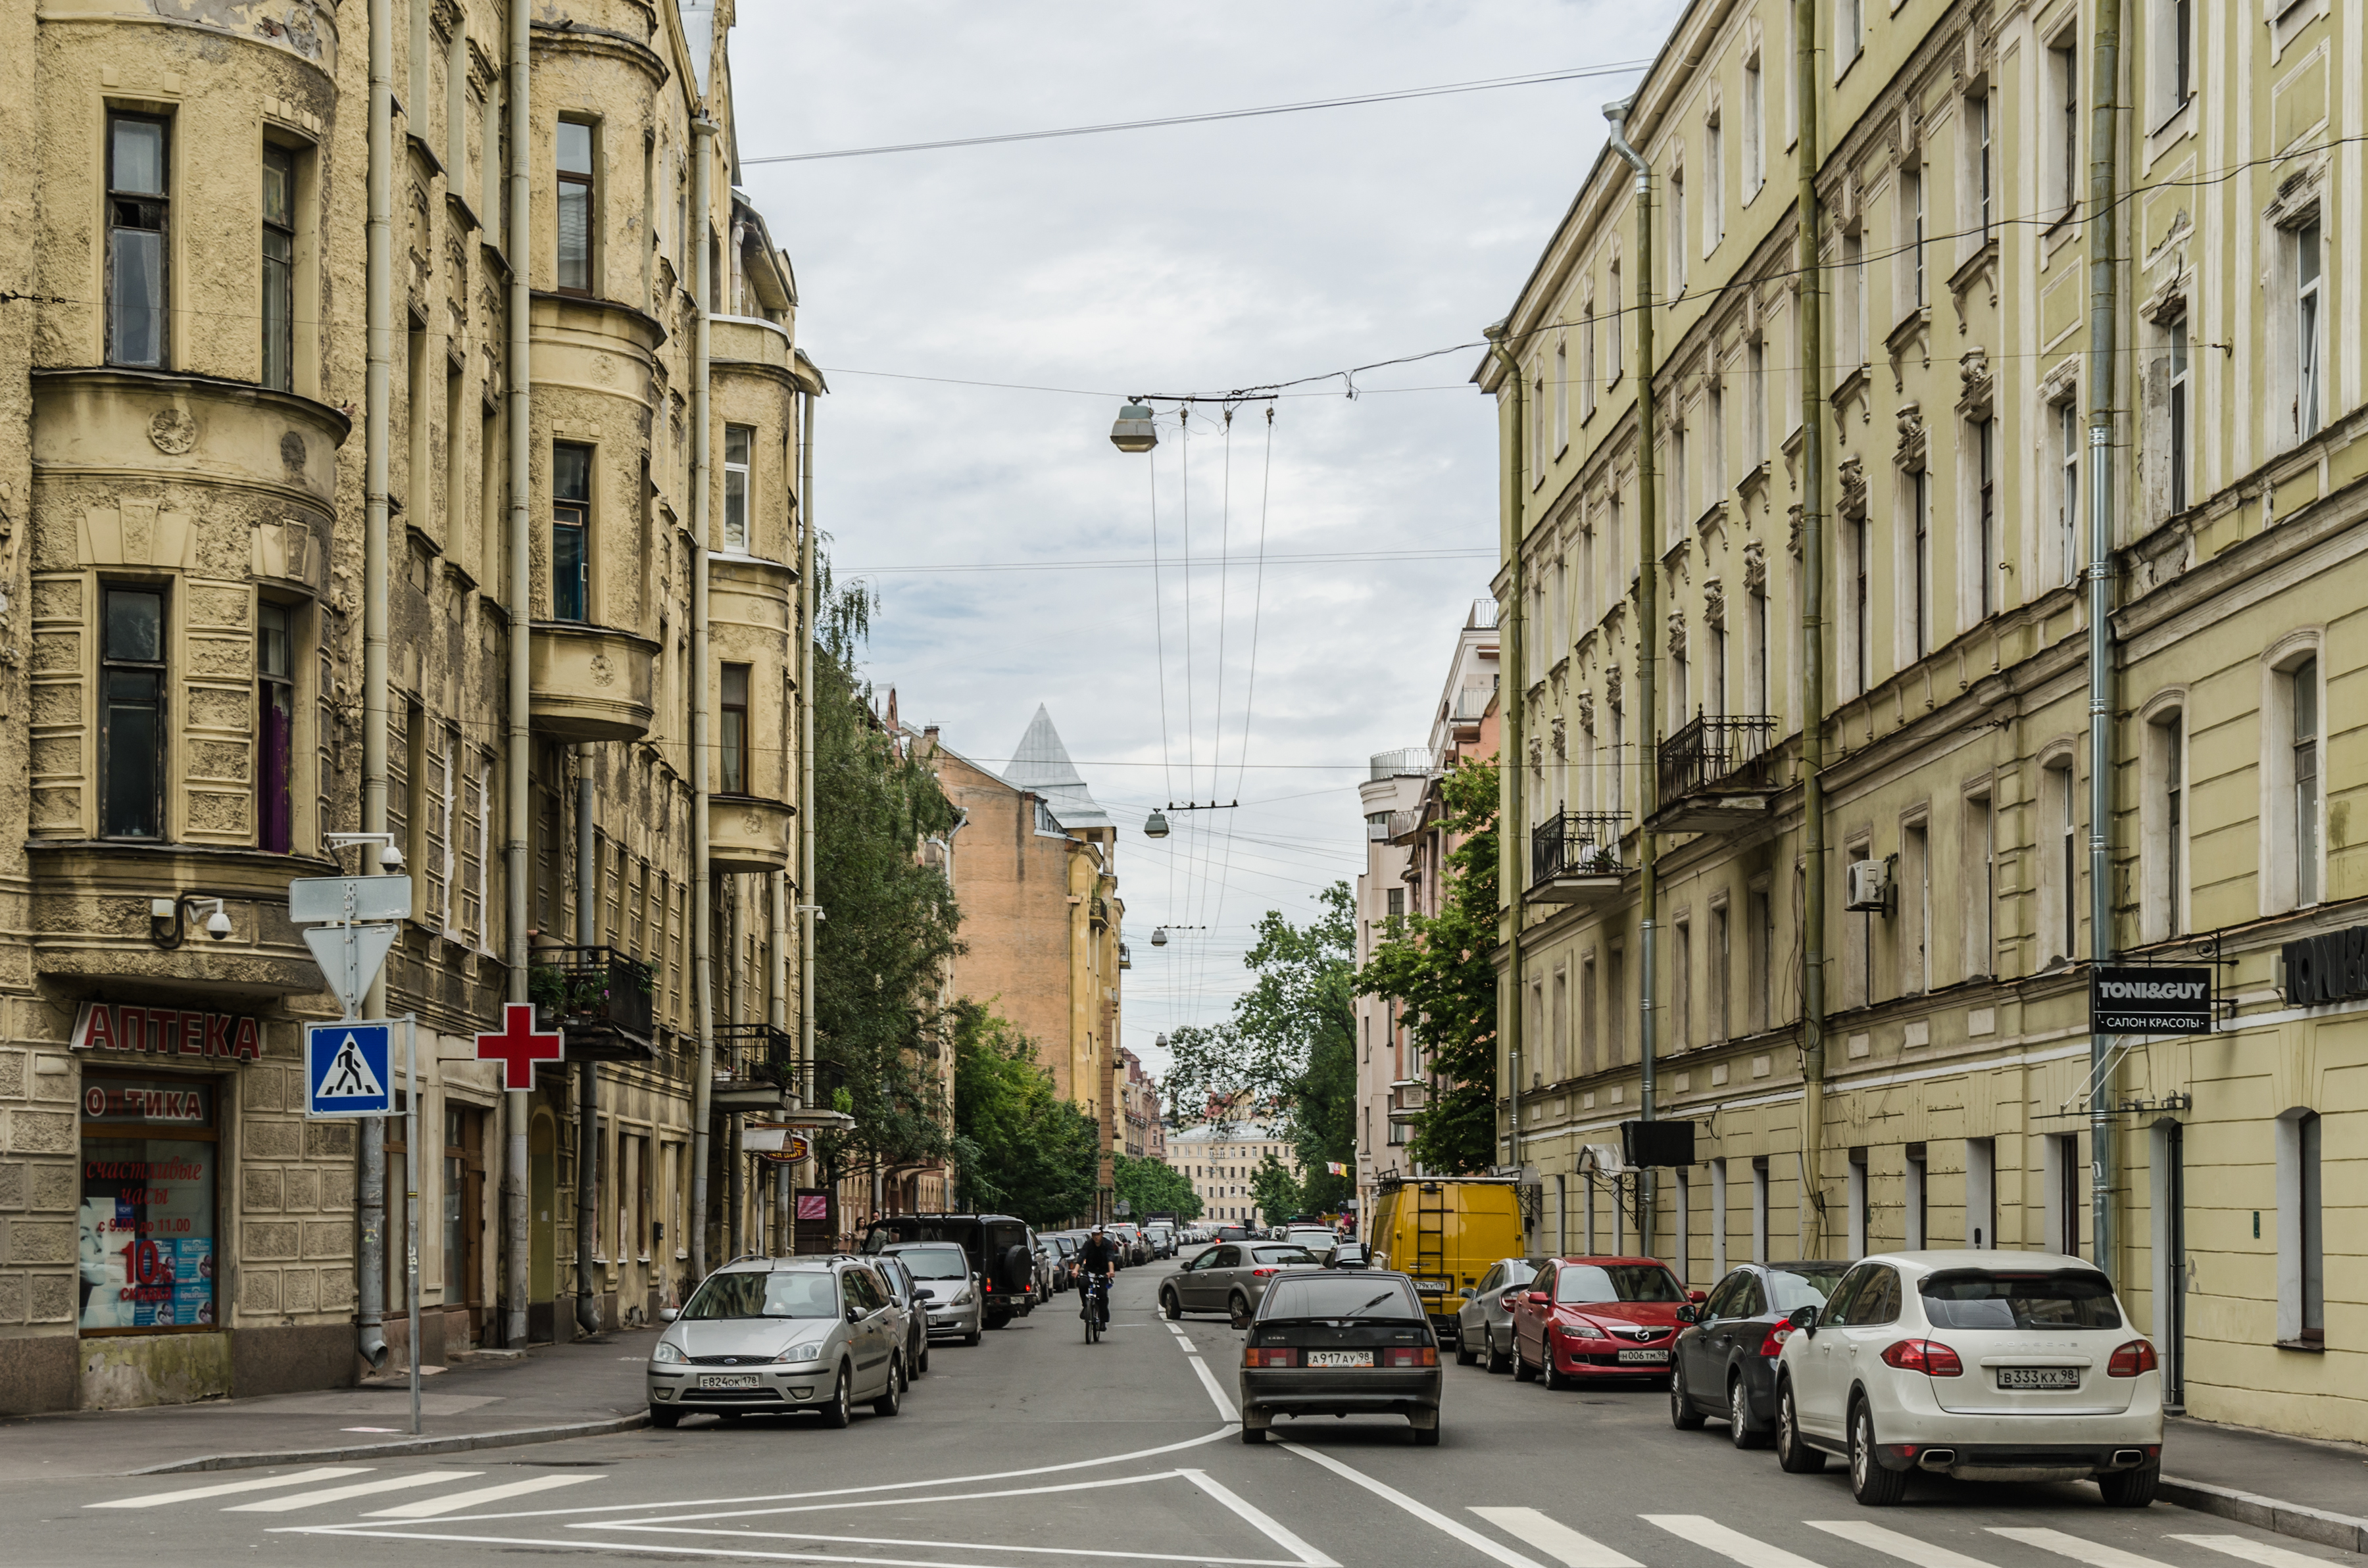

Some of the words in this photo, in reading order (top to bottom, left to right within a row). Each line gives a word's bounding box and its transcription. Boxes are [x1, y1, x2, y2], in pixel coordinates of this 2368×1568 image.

[2099, 982, 2206, 999] TONI&GUY
[78, 1002, 262, 1060] АПТЕКА
[2106, 1017, 2146, 1027] САЛОН
[2149, 1018, 2200, 1028] КРАСОТЫ
[86, 1087, 203, 1120] ОПТИКА
[86, 1156, 202, 1181] счастливые
[121, 1188, 169, 1205] часы
[109, 1218, 136, 1233] 9.00
[139, 1221, 155, 1235] до
[159, 1218, 191, 1233] 11.00
[121, 1240, 172, 1285] 10%
[120, 1286, 172, 1302] скидка
[1358, 1352, 1369, 1361] 98
[742, 1376, 757, 1384] 178
[2061, 1369, 2074, 1380] 98
